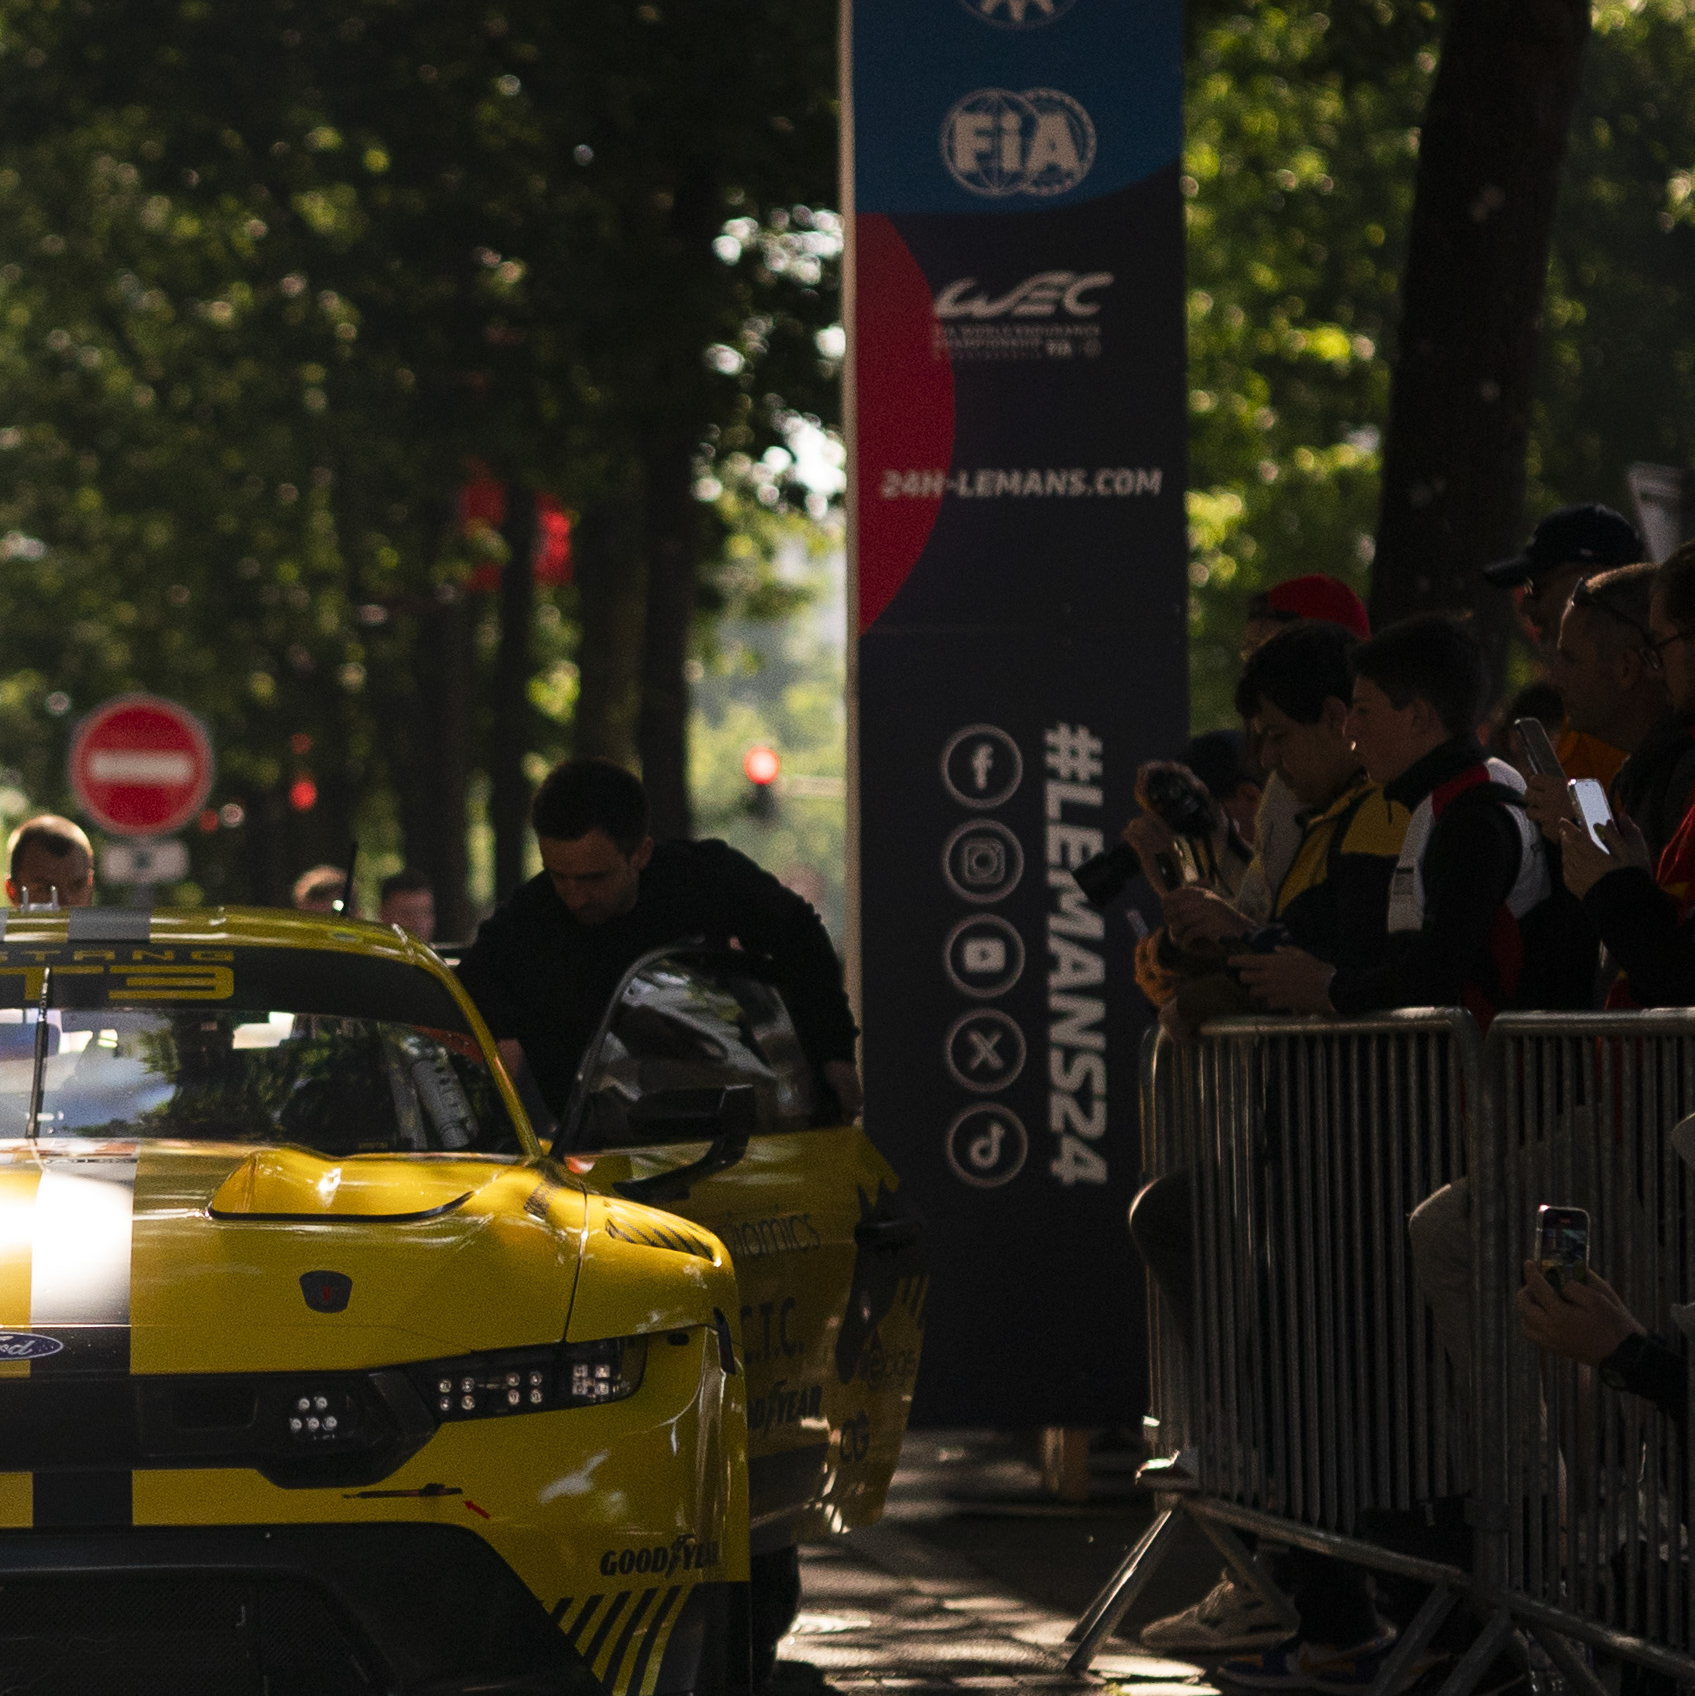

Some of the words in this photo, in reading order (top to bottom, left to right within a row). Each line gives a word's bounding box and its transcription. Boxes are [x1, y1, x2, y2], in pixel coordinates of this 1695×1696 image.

[934, 268, 1115, 318] WEC
[879, 468, 1163, 502] 24H-LEMANS.COM
[1042, 721, 1108, 1187] #LEMANS24
